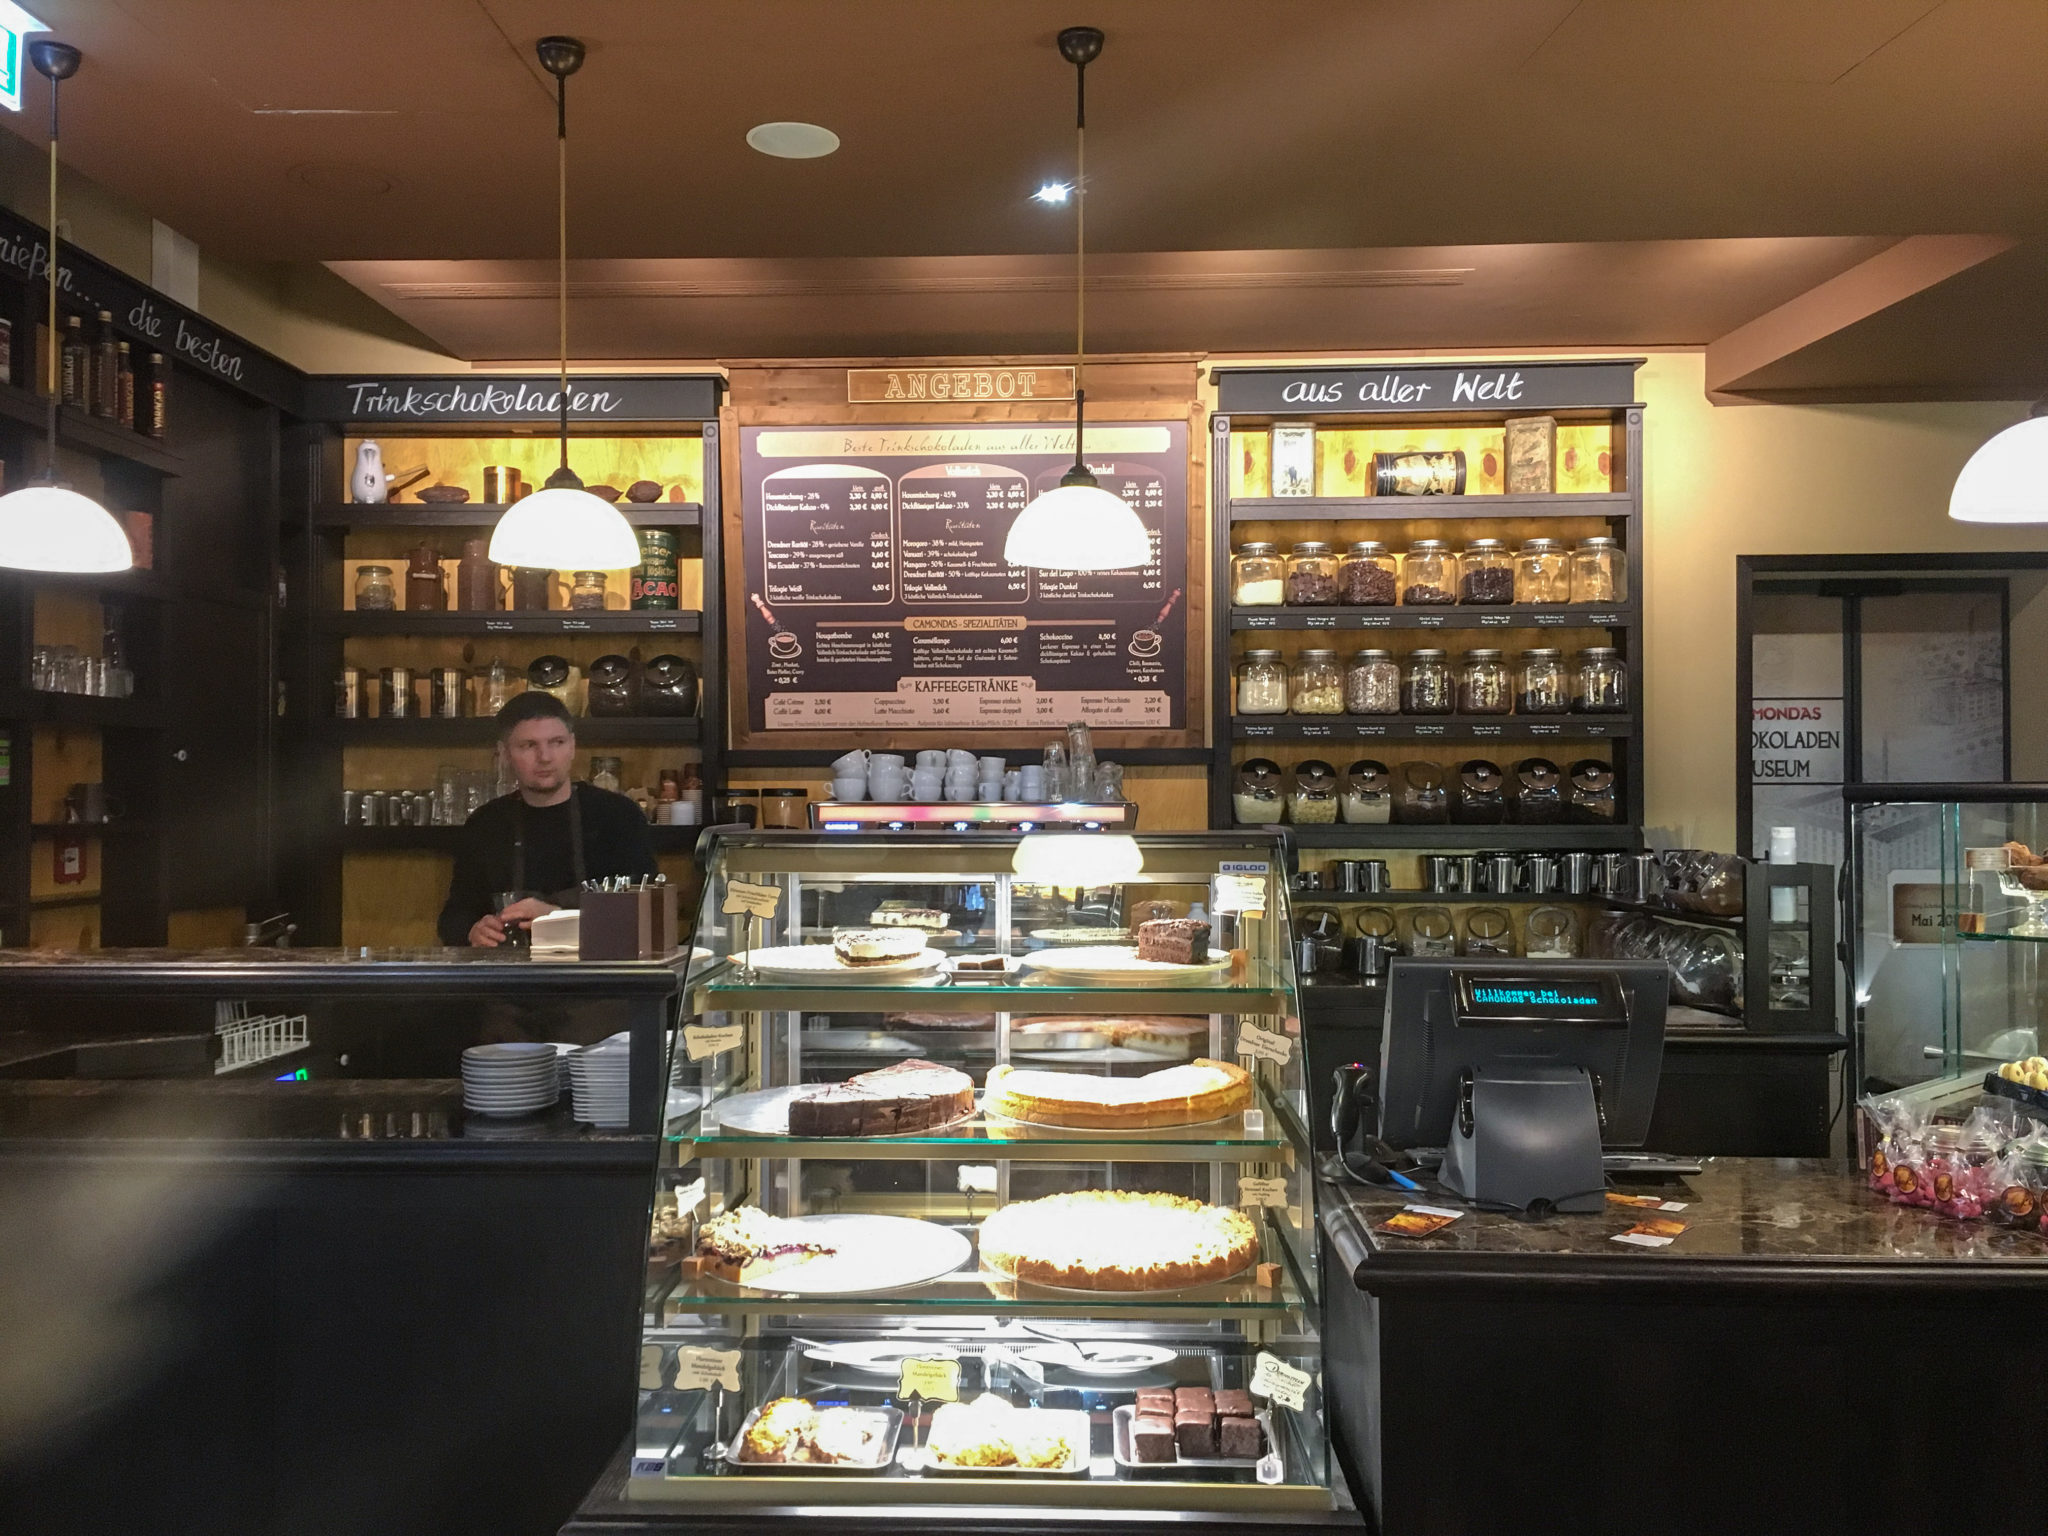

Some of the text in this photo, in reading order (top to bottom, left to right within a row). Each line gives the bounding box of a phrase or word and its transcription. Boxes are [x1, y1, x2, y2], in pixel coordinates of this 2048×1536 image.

[128, 297, 244, 382] die besten
[884, 371, 1036, 399] ANGEBOT
[1281, 370, 1525, 403] aus aller Welt
[347, 382, 622, 416] Trinkschokoladen
[844, 437, 873, 453] Beste
[879, 433, 981, 453] Trinkschokoladen
[1086, 463, 1115, 475] Dunkel
[912, 617, 1018, 629] CAMONDAS SPEZIALITÄTEN
[914, 678, 1018, 693] KAFFEEGETRÄNKE
[1232, 864, 1266, 872] IGLOO
[1911, 913, 1934, 927] Mai
[1474, 988, 1559, 998] Willkommen bei
[1530, 996, 1599, 1005] Schokoladen
